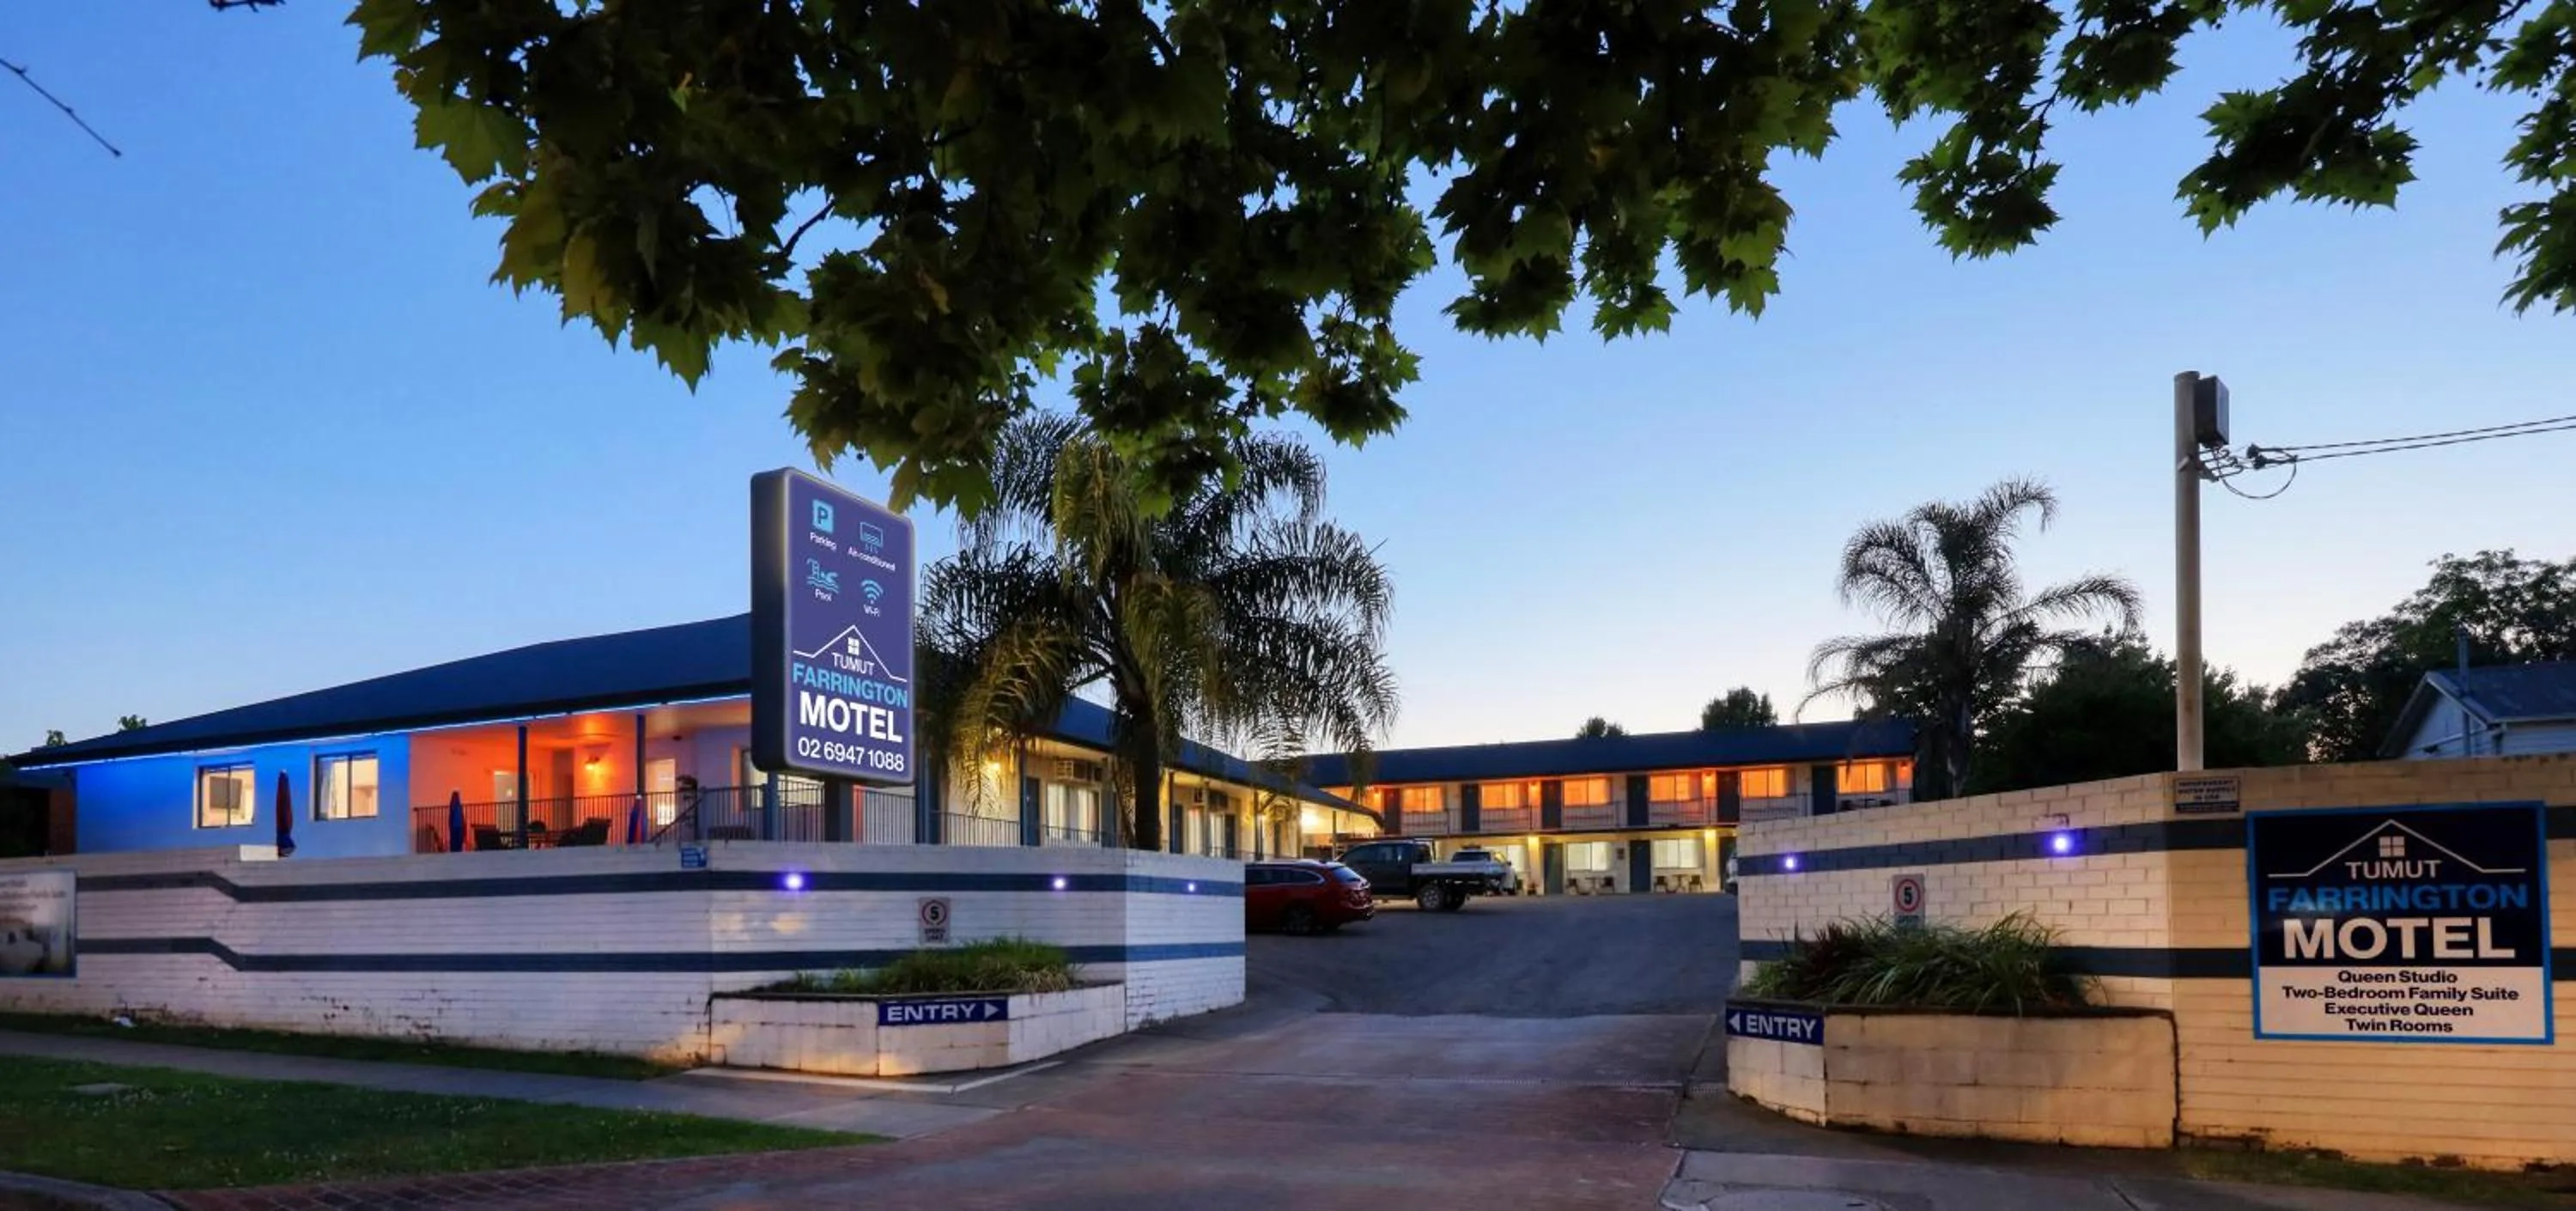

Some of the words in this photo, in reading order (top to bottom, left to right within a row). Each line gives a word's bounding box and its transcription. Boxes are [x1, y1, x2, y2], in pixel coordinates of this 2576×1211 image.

[810, 532, 837, 552] Parking
[815, 588, 832, 602] Pool
[831, 652, 875, 676] TUMUT
[792, 662, 908, 709] FARRINGTON
[799, 691, 903, 743] MOTEL
[798, 737, 821, 758] 02
[823, 741, 865, 765] 6947
[867, 749, 904, 772] 1088
[2345, 860, 2442, 879] TUMUT
[1903, 885, 1913, 906] 5
[2268, 883, 2528, 912] FARRINGTON
[930, 905, 940, 921] 5
[2282, 916, 2516, 959] MOTEL
[2337, 971, 2397, 983] Queen
[2398, 970, 2458, 983] Studio
[2281, 985, 2406, 1000] Two-Bedroom
[2409, 987, 2467, 1002] Family
[2470, 987, 2519, 1001] Suite
[886, 1002, 976, 1022] ENTRY
[2324, 1002, 2411, 1016] Executive
[2414, 1003, 2474, 1017] Queen
[1746, 1013, 1818, 1039] ENTRY
[2345, 1018, 2387, 1031] Twin
[2390, 1019, 2453, 1033] Rooms
